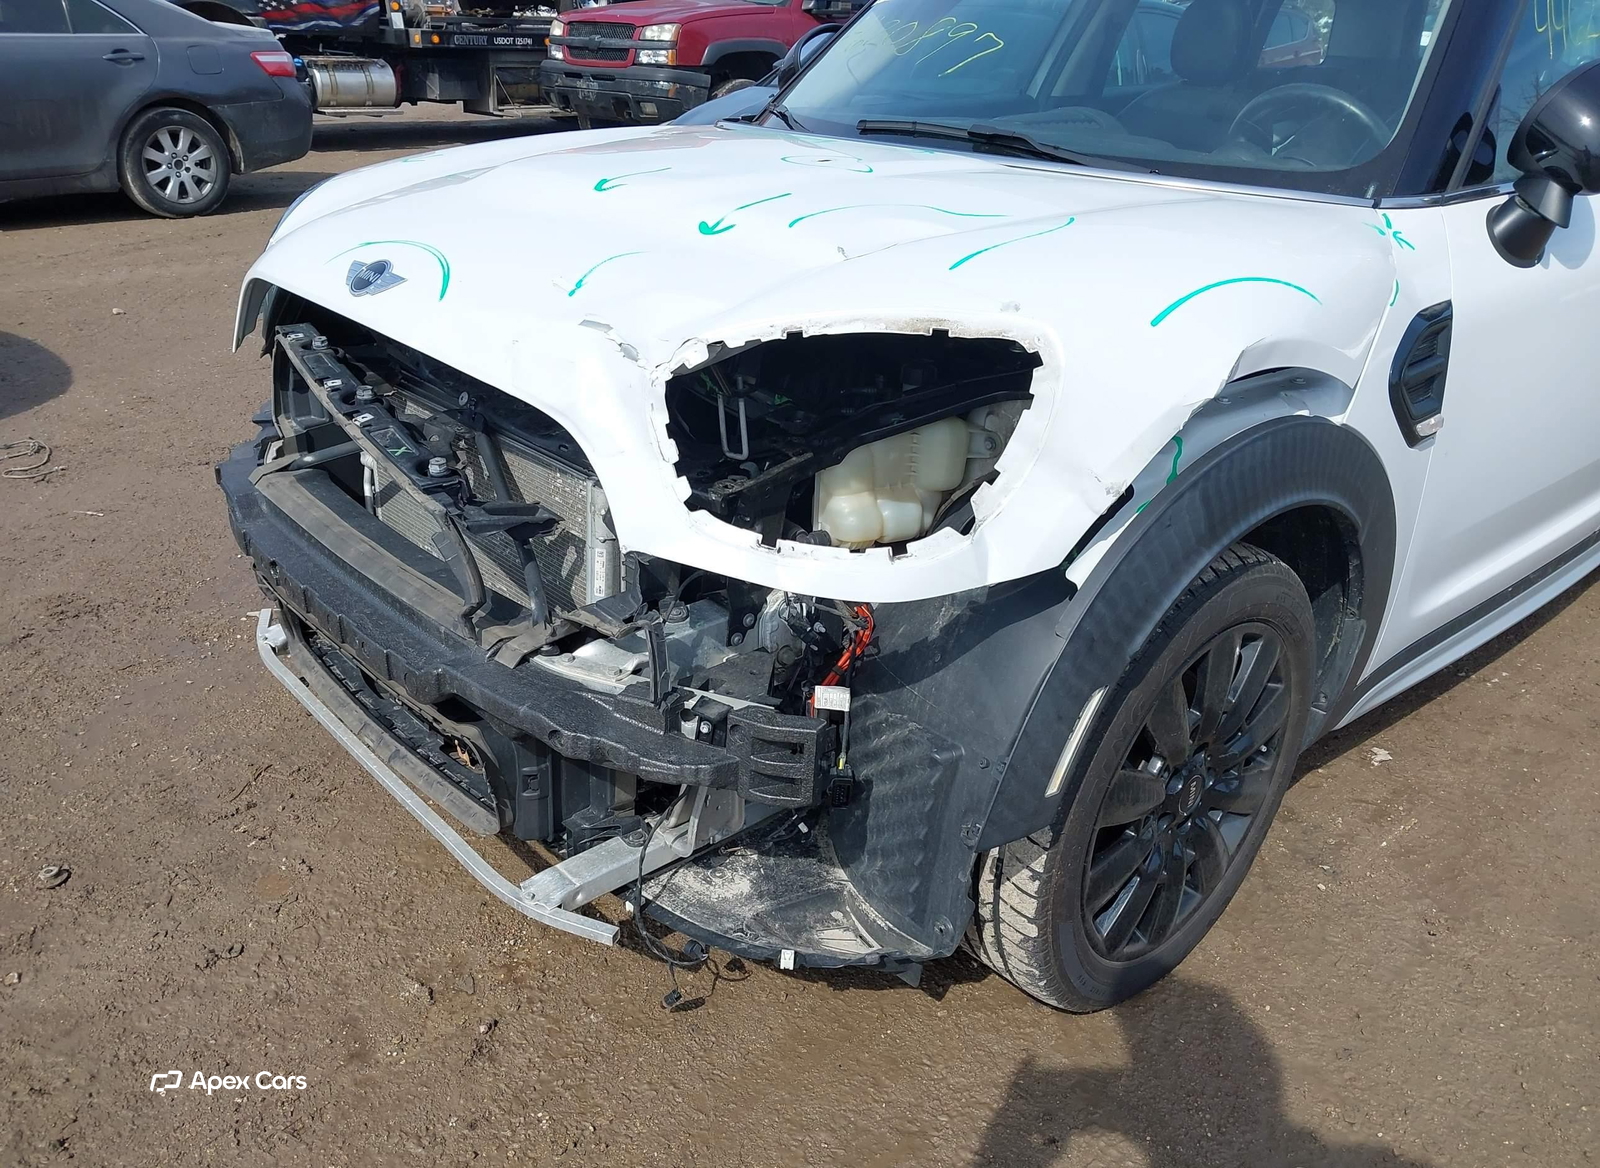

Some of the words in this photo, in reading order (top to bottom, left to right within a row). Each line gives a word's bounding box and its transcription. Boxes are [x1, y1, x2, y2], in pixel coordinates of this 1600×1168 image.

[454, 34, 488, 45] CENTURY
[493, 36, 514, 45] USDOT
[359, 268, 381, 283] MINI
[1187, 781, 1197, 808] MINI
